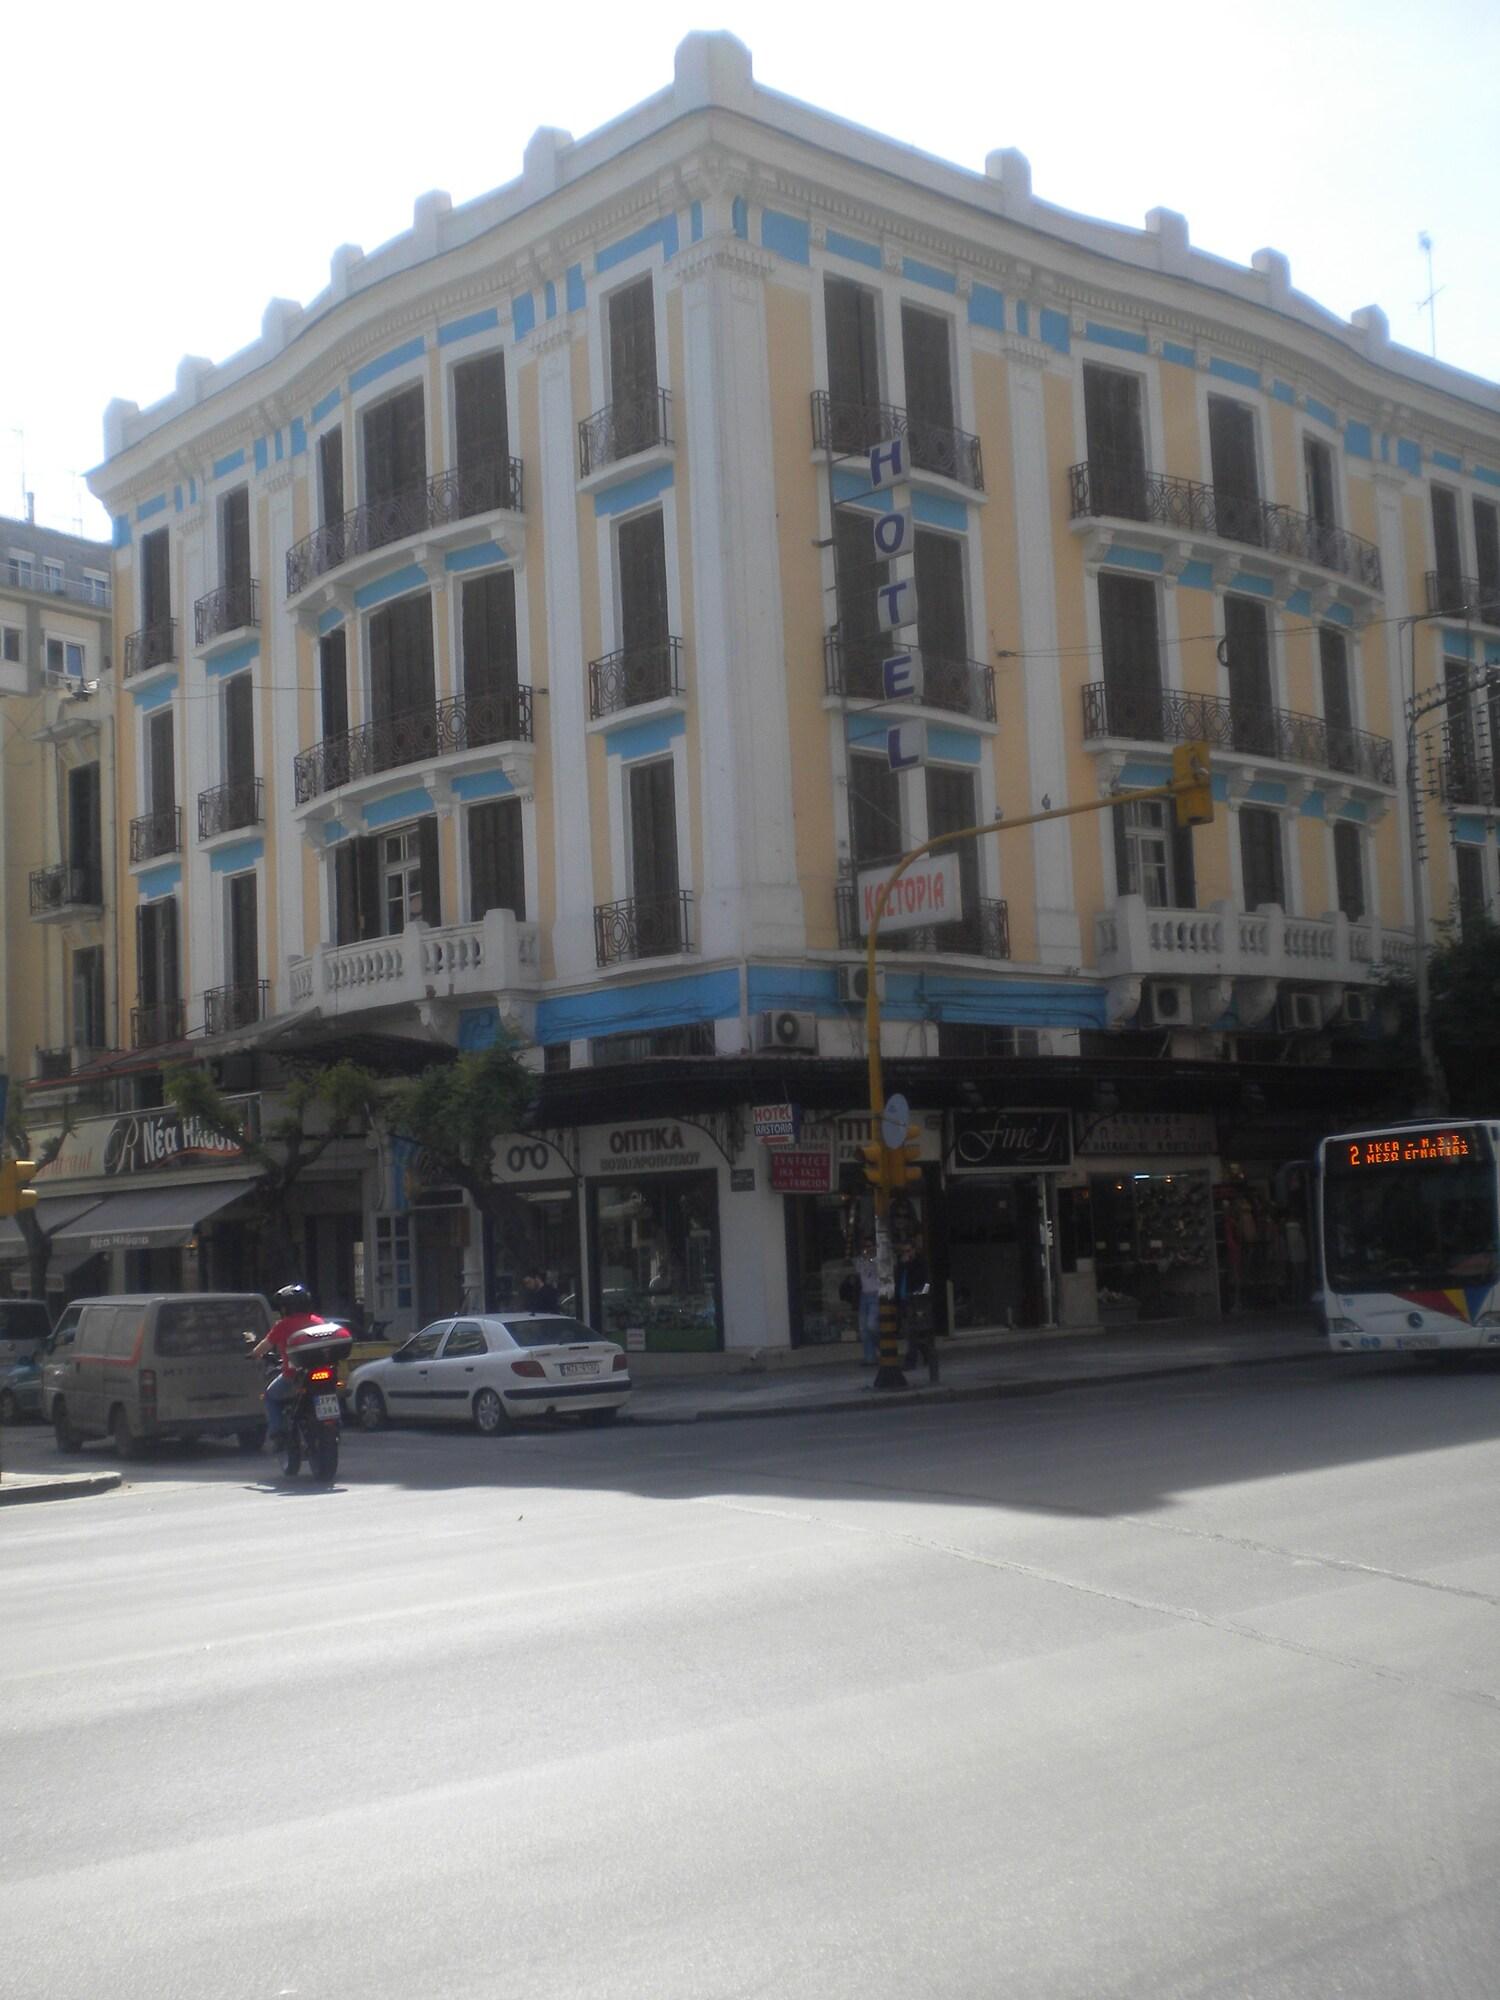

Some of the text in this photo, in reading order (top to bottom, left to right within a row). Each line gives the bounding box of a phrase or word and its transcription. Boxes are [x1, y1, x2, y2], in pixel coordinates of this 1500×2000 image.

[870, 440, 919, 769] HOTEL
[754, 1104, 791, 1123] HOTEL
[755, 1122, 792, 1136] KASTORIA
[143, 1116, 178, 1164] Νέα
[609, 1126, 684, 1154] ΟΠΤΙΚΑ
[1367, 1141, 1400, 1153] IKEA
[1350, 1145, 1360, 1165] 2
[1367, 1145, 1469, 1164] ΜΕΣΩ ΕΓΝΑΤΙΑΣ
